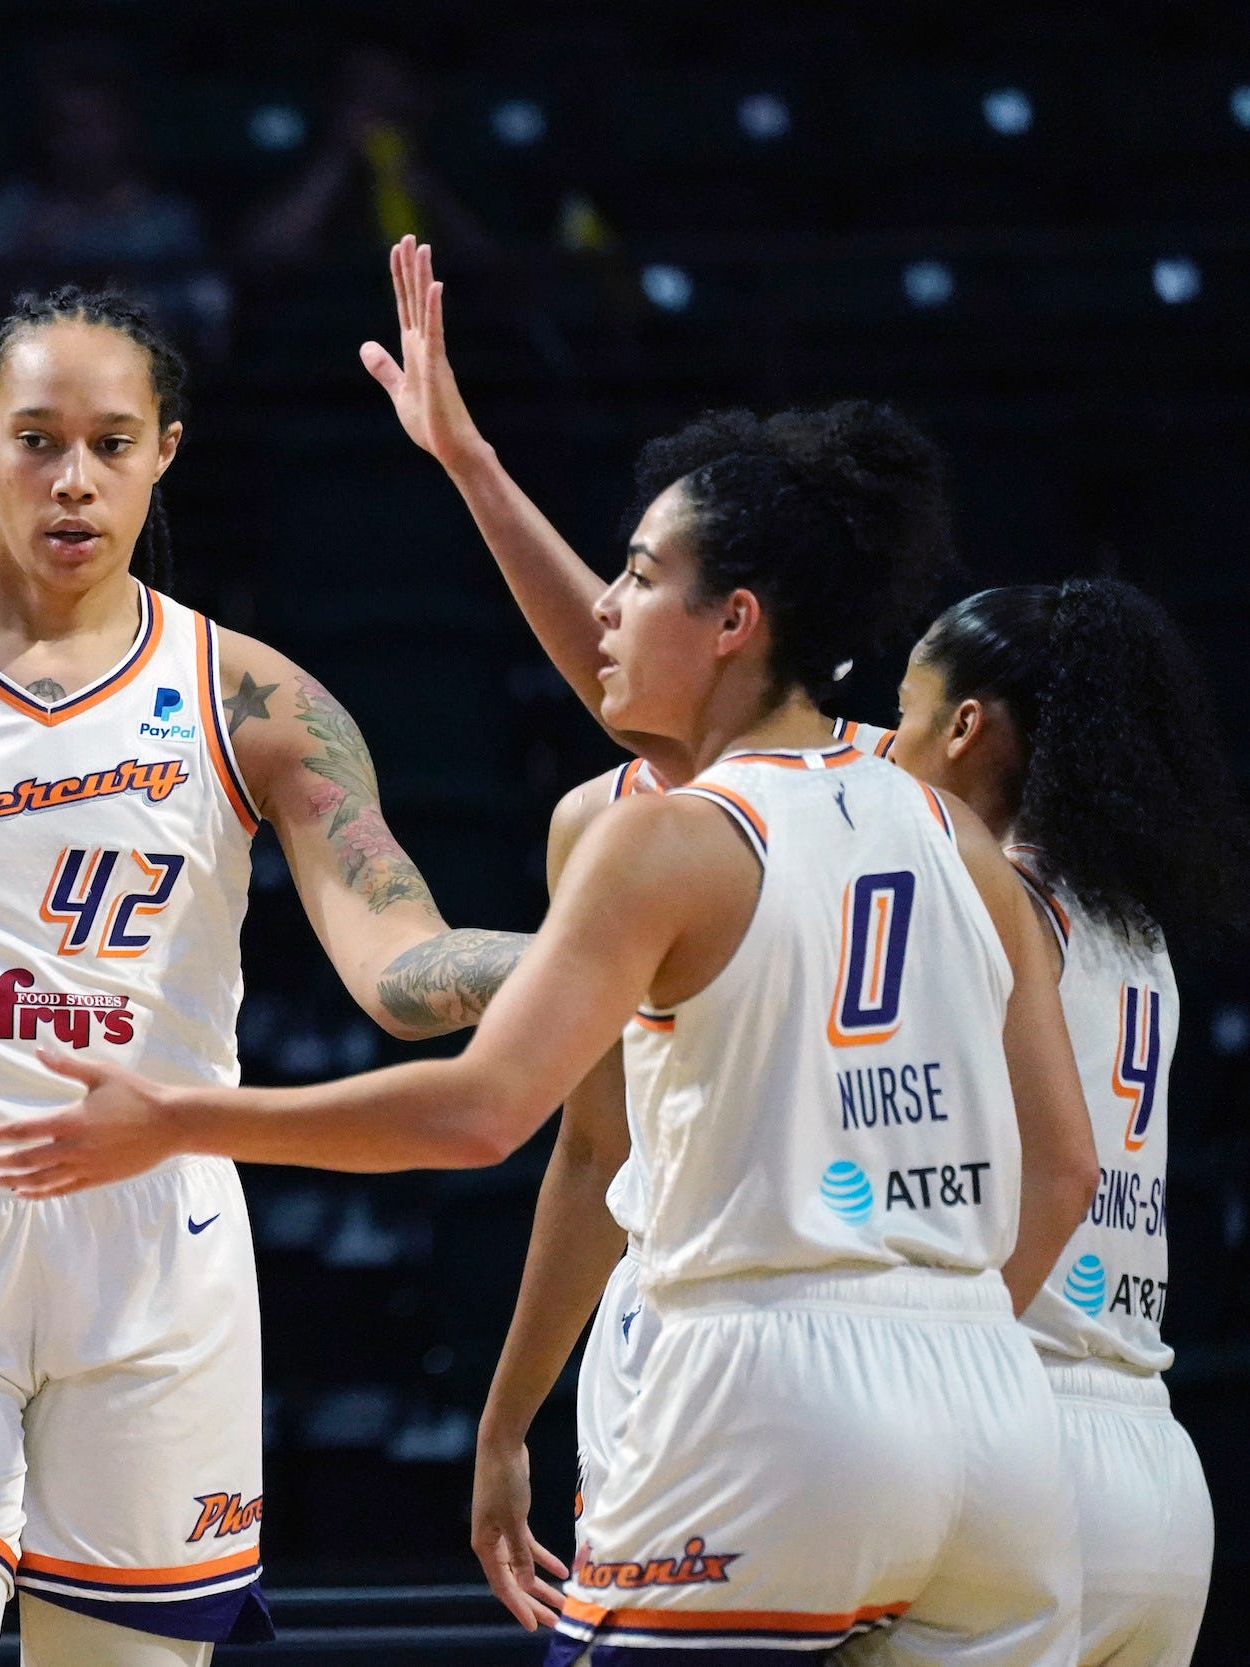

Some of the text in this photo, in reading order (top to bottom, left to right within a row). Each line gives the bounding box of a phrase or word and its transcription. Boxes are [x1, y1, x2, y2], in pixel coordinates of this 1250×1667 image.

[140, 722, 196, 739] PayPal
[39, 847, 185, 958] 42
[827, 870, 916, 1048] 0
[17, 992, 122, 1007] FOOD STORES
[1111, 979, 1161, 1152] 4
[837, 1063, 948, 1131] NURSE
[885, 1162, 990, 1211] AT&T
[1085, 1167, 1168, 1237] GINS-S
[1109, 1273, 1168, 1322] AT&T
[572, 1537, 743, 1589] hoenix
